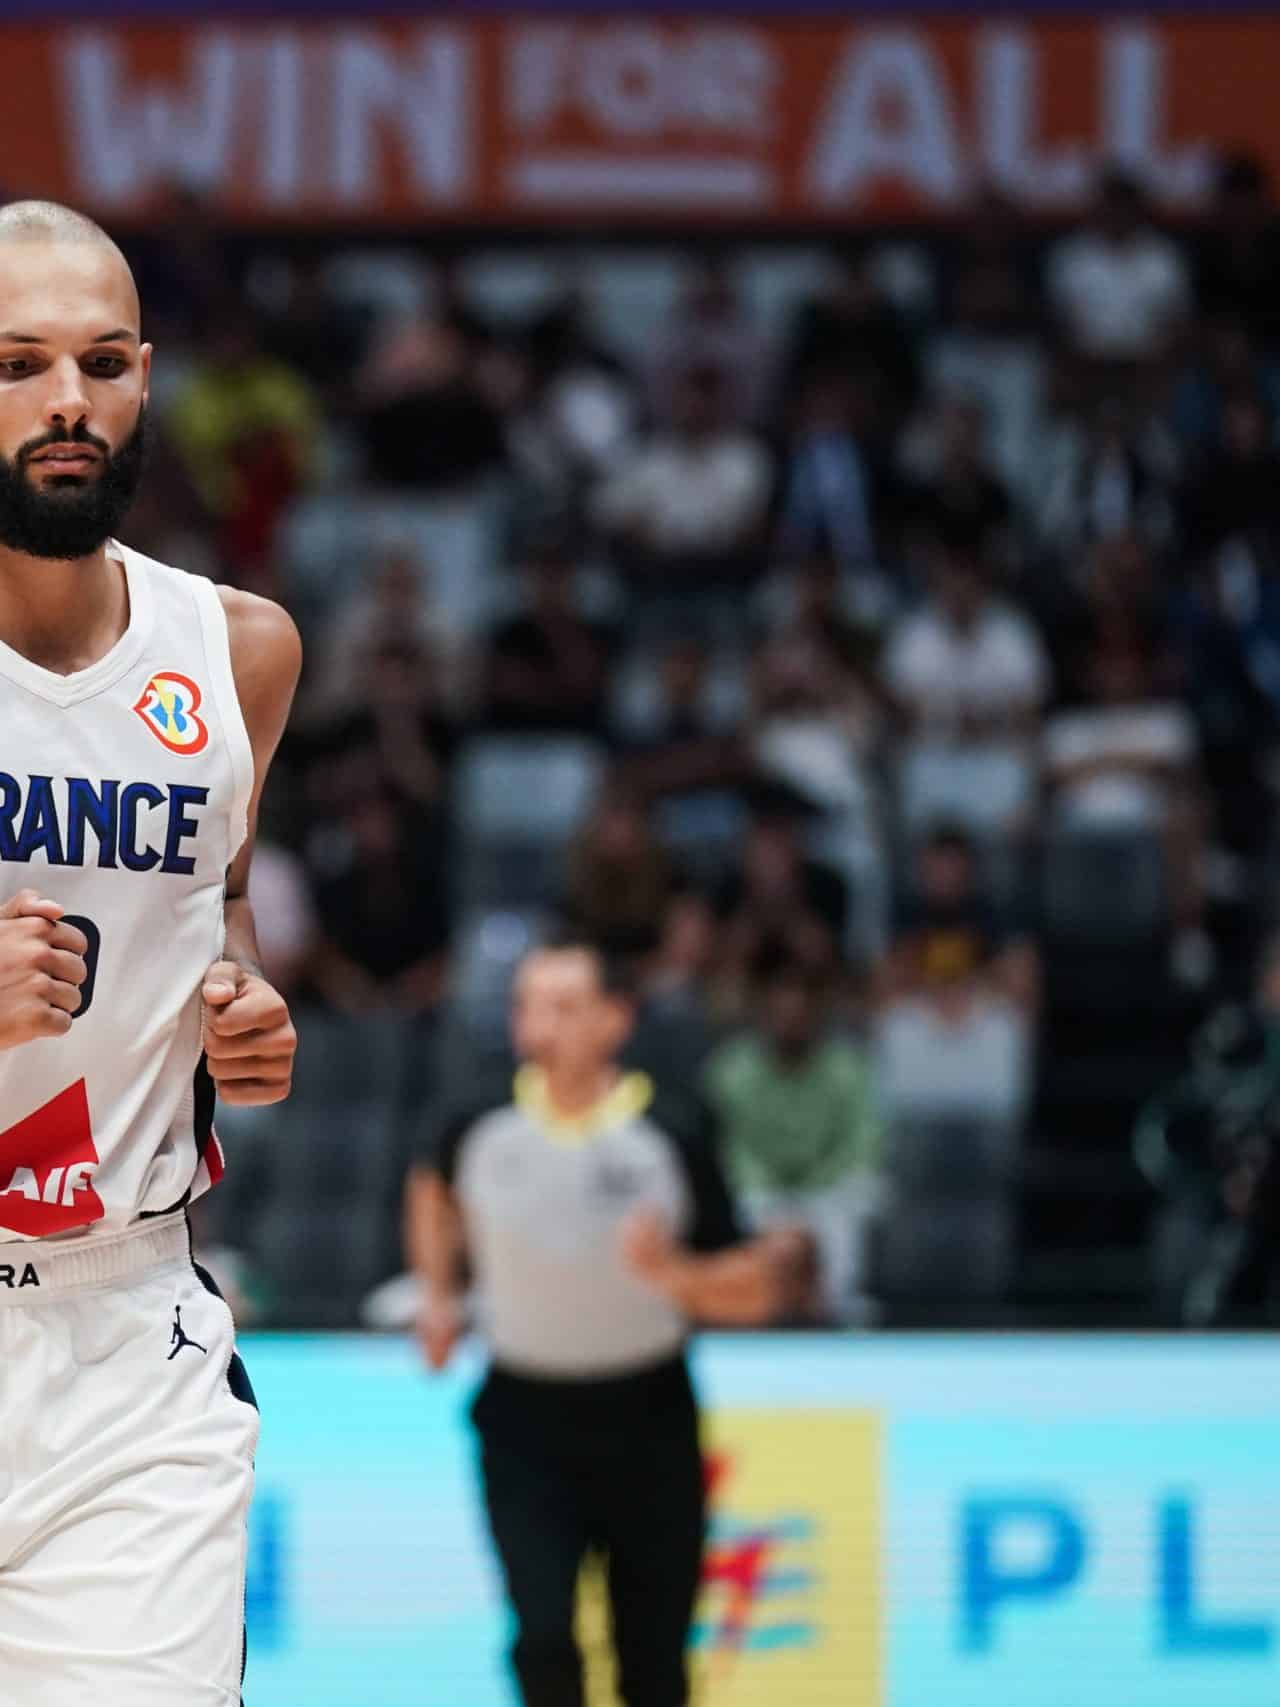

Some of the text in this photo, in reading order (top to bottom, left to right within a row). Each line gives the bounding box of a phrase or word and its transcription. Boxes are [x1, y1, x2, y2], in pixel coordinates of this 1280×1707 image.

[61, 26, 1208, 206] WIN FOR ALL
[958, 1490, 1272, 1656] PL
